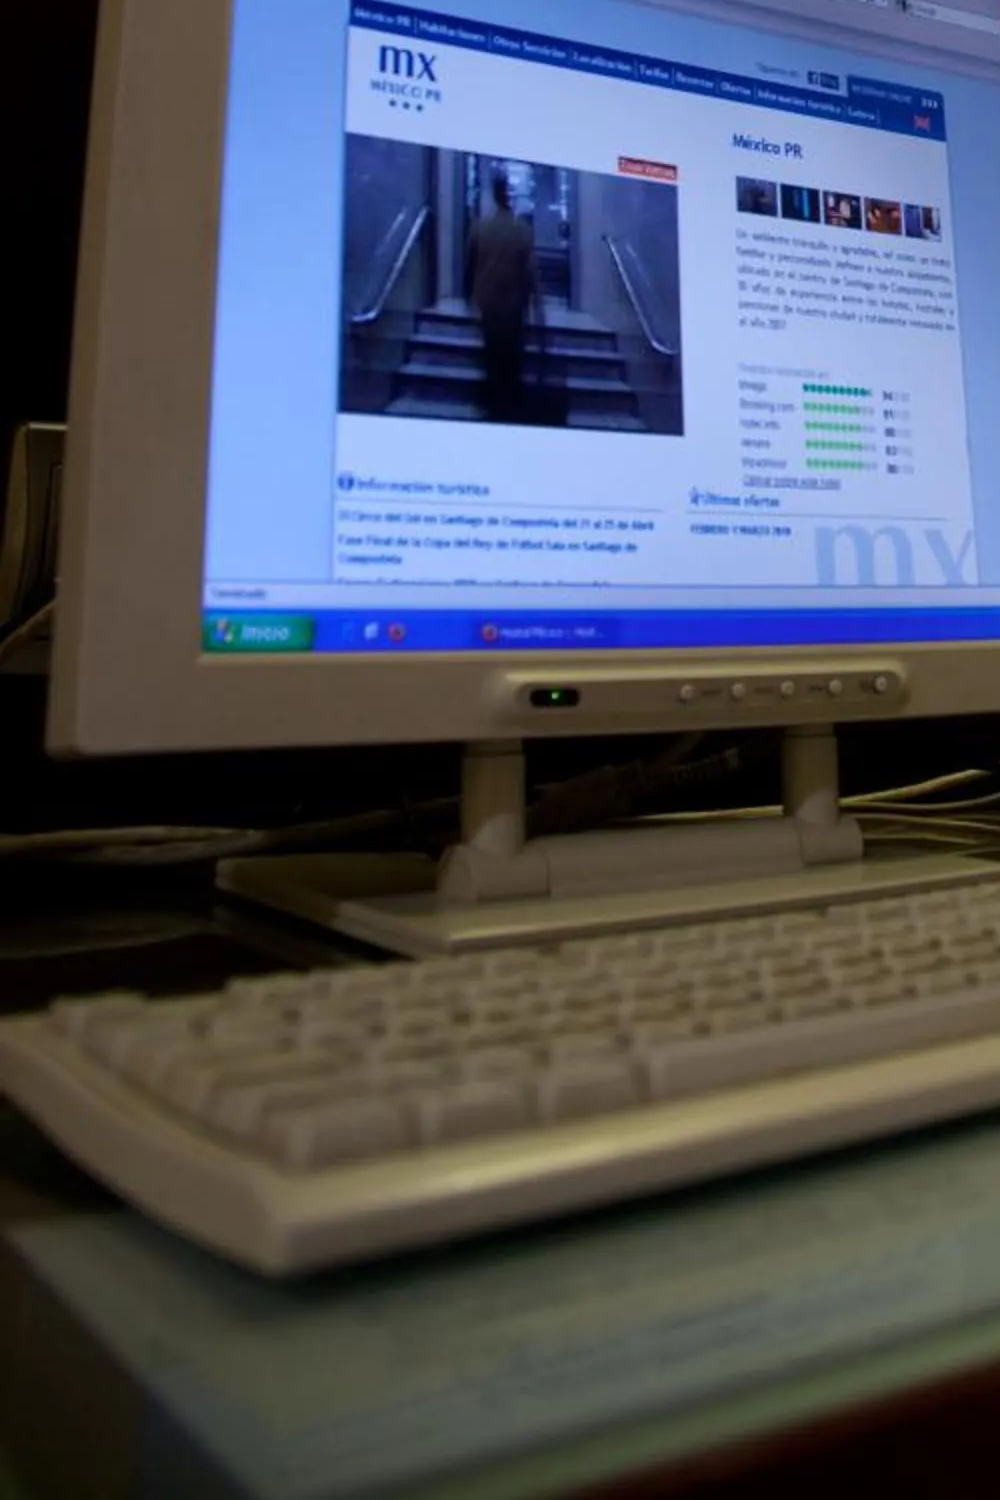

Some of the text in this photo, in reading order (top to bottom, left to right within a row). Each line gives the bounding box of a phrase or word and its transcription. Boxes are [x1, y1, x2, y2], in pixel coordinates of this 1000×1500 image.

[379, 44, 437, 83] mx
[733, 132, 803, 159] México PR
[240, 624, 290, 642] Inicio
